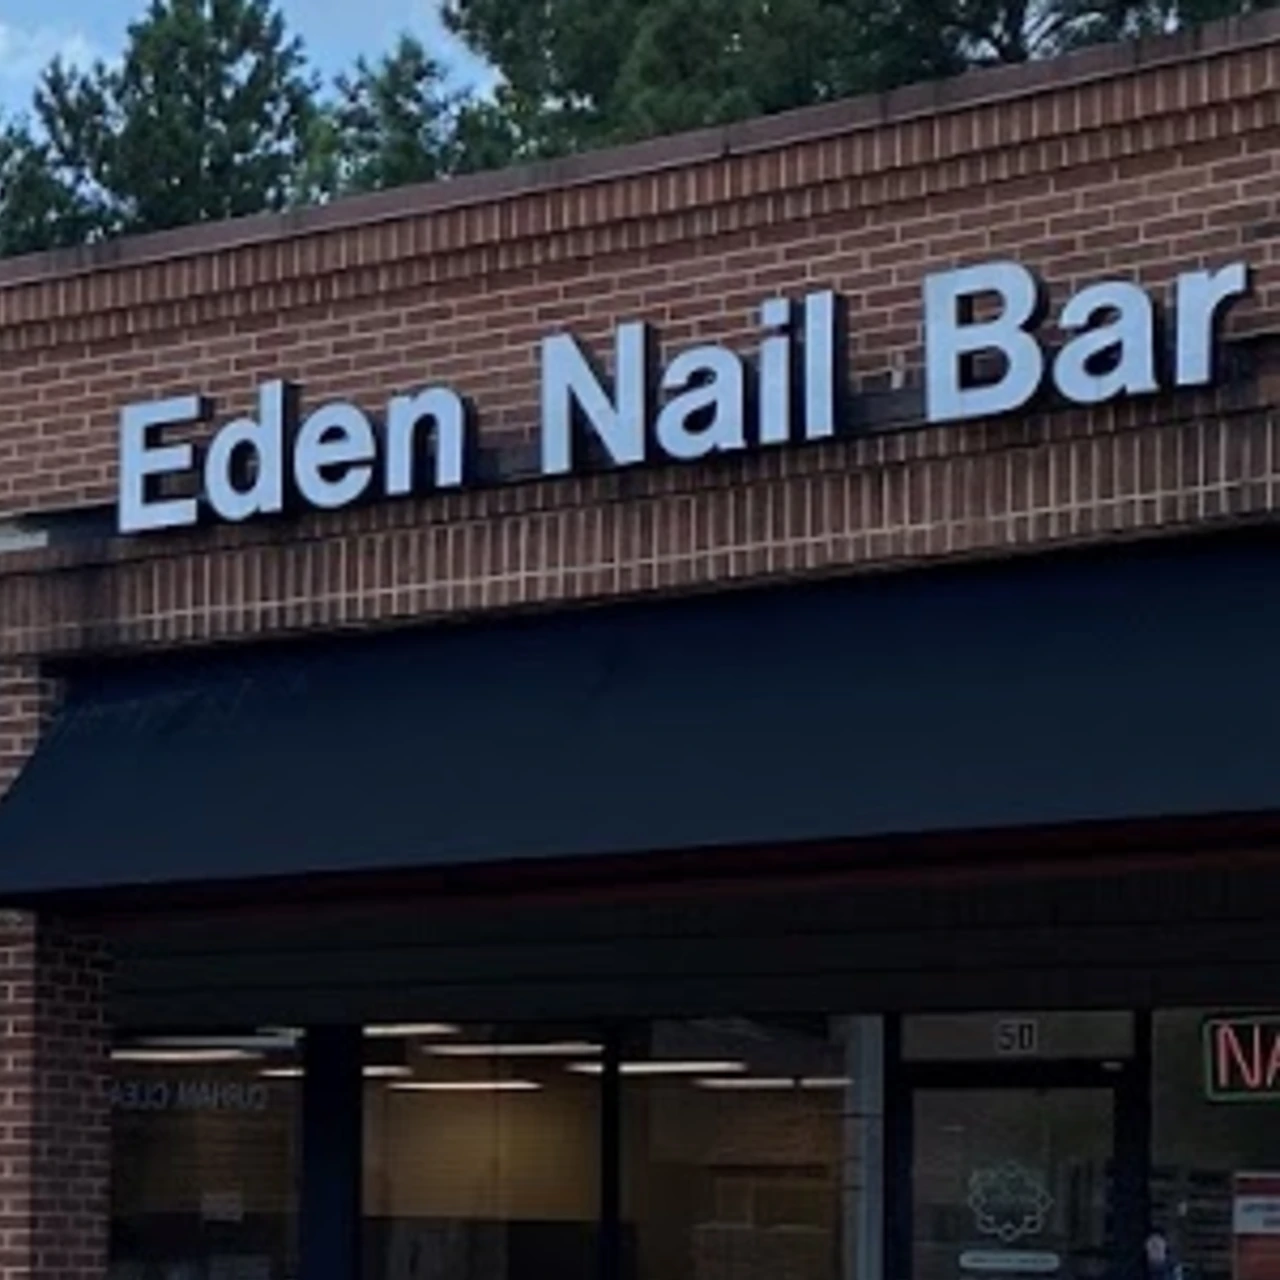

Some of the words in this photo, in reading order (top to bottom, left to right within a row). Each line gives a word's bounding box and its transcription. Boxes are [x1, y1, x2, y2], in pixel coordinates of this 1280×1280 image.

[117, 380, 466, 534] Eden
[540, 289, 835, 475] Nail
[923, 260, 1248, 424] Bar
[998, 1023, 1034, 1050] 50
